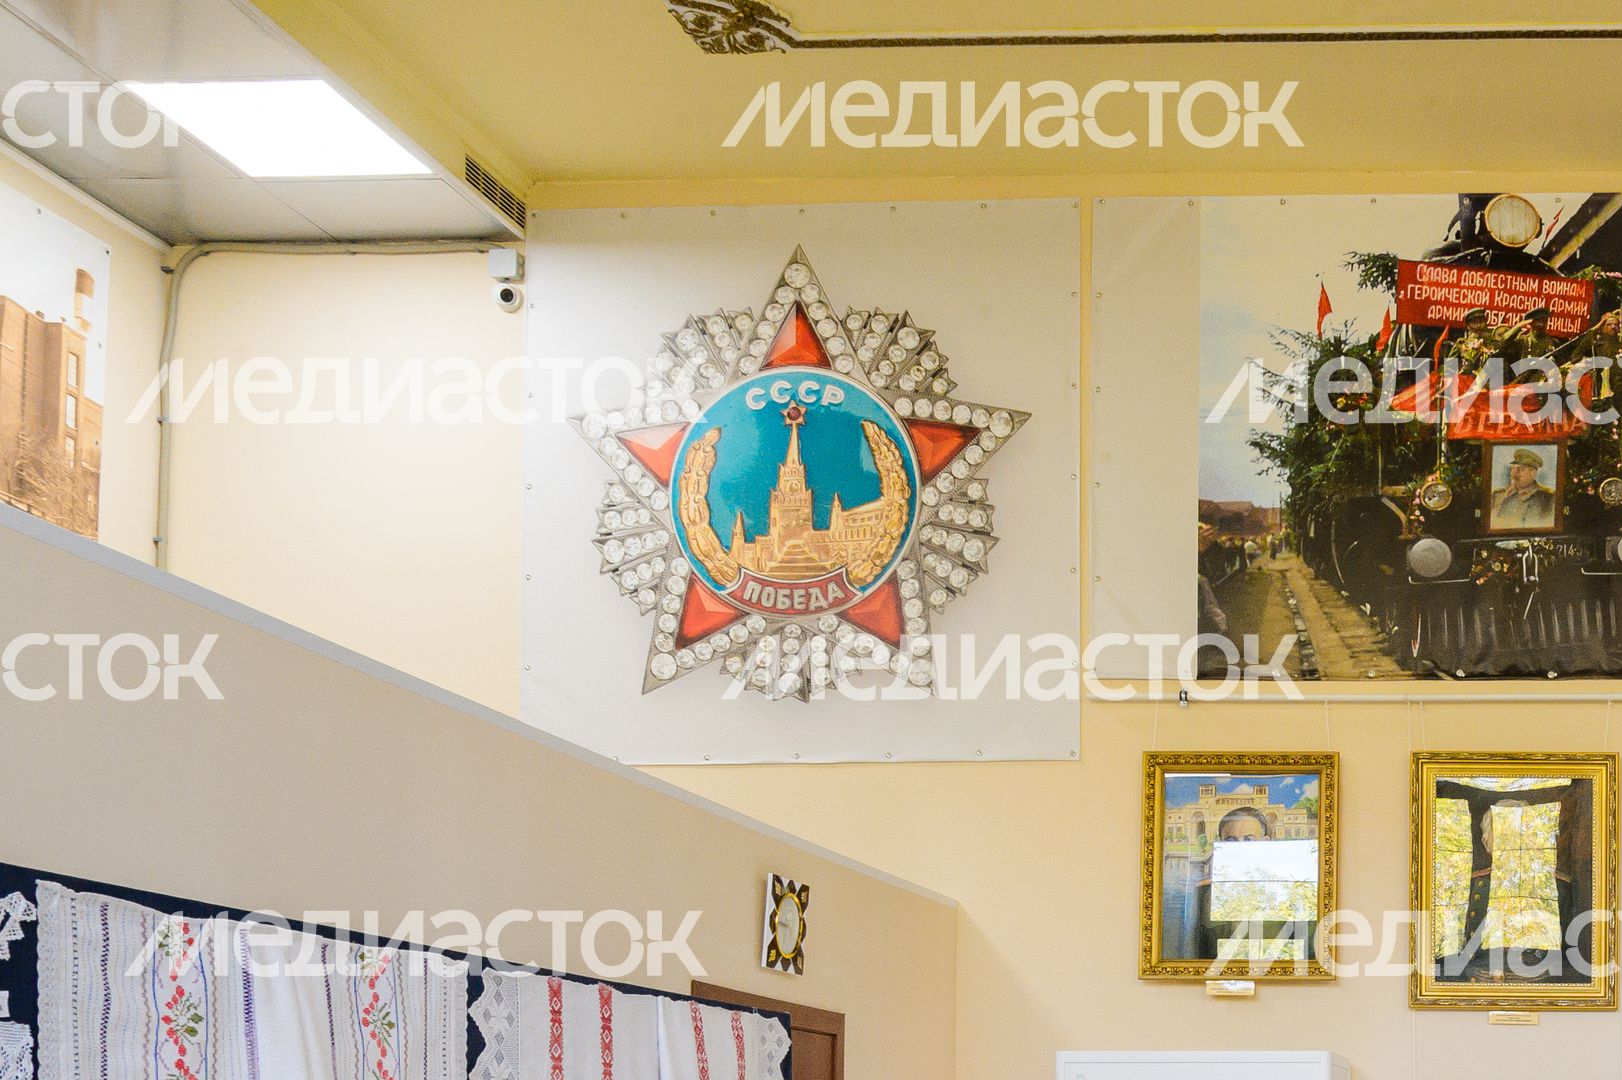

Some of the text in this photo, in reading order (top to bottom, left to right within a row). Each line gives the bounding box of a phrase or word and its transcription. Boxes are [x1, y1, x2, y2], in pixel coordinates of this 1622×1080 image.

[1460, 270, 1539, 293] ДОБЛЕСТНЫМ
[1542, 279, 1586, 298] ВОИНАМ
[745, 380, 845, 411] СССР
[742, 581, 845, 611] ПОБЕДА
